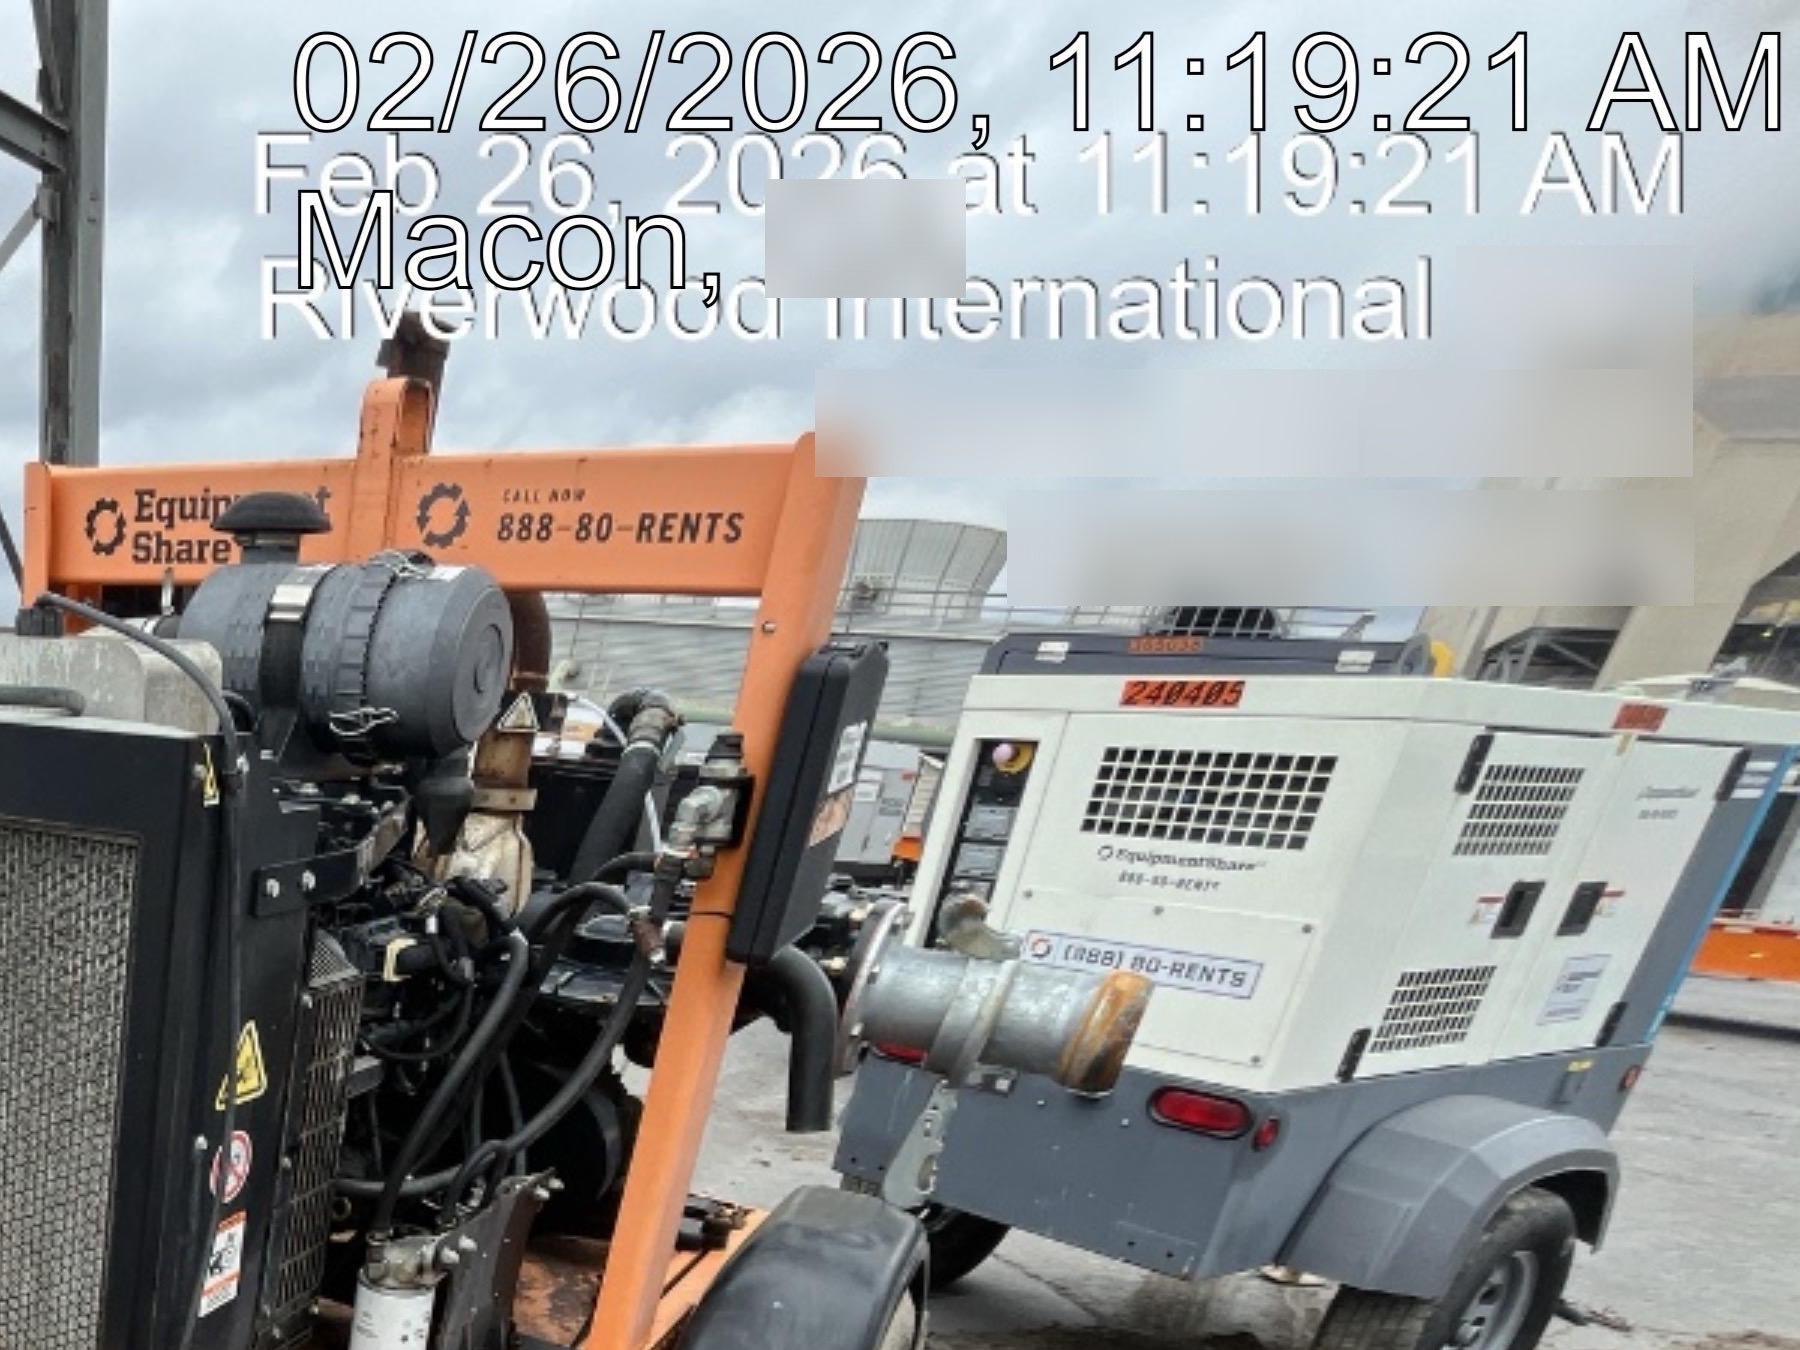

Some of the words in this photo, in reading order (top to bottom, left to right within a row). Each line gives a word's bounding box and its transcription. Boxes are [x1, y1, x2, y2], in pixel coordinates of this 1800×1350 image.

[498, 512, 745, 544] 888-80-RENTS
[132, 530, 232, 564] Share
[1121, 681, 1245, 707] 240405
